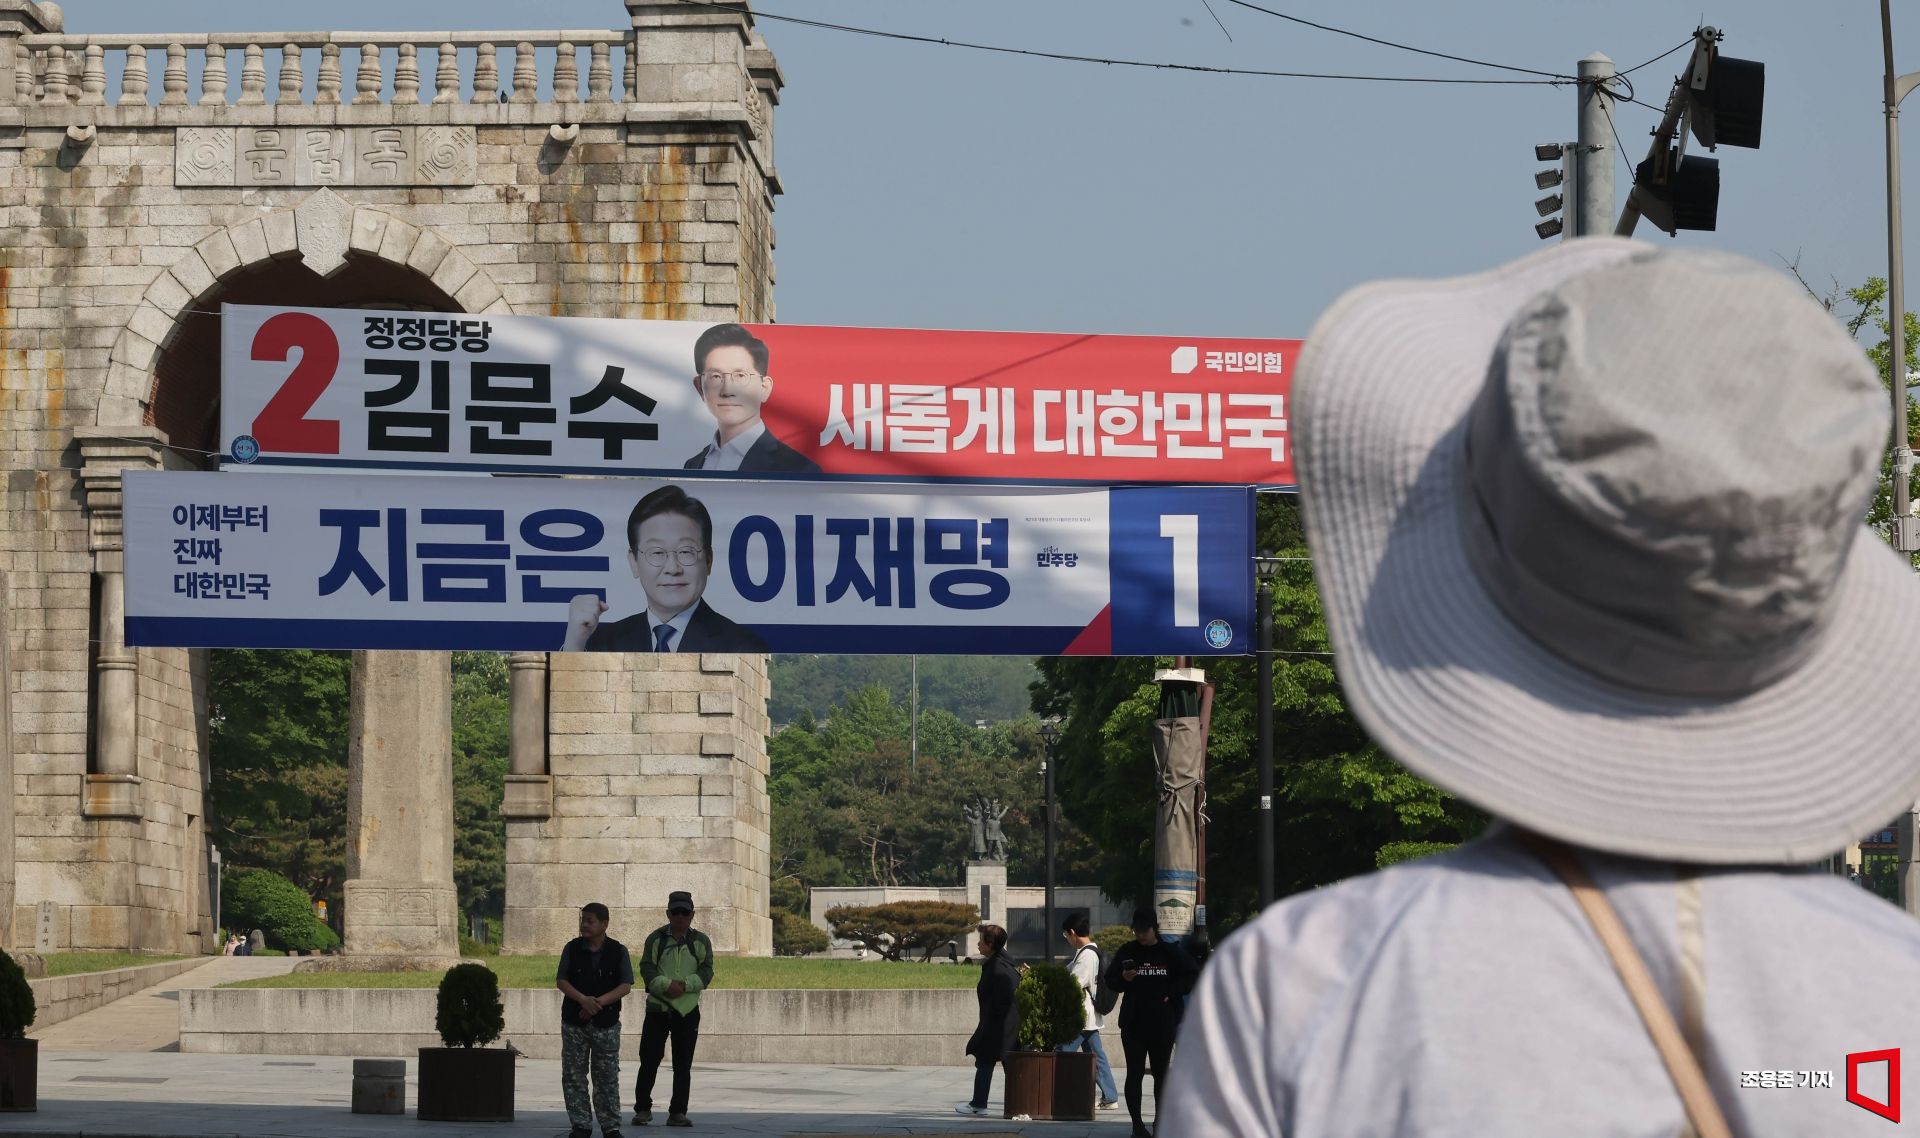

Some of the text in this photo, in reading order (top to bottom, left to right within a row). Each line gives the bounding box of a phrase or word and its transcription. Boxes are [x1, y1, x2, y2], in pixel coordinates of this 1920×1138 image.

[364, 316, 492, 353] 정정당당
[1204, 351, 1282, 374] 국민의힘
[251, 311, 340, 455] 2
[364, 358, 659, 461] 김문수
[820, 382, 1288, 462] 새롭게 대한민국
[172, 503, 269, 533] 이제부터
[172, 537, 223, 566] 진짜
[318, 507, 1012, 610] 지금은 이재명
[1036, 552, 1079, 568] 민주당
[173, 571, 272, 601] 대한민국
[1159, 514, 1200, 628] 1
